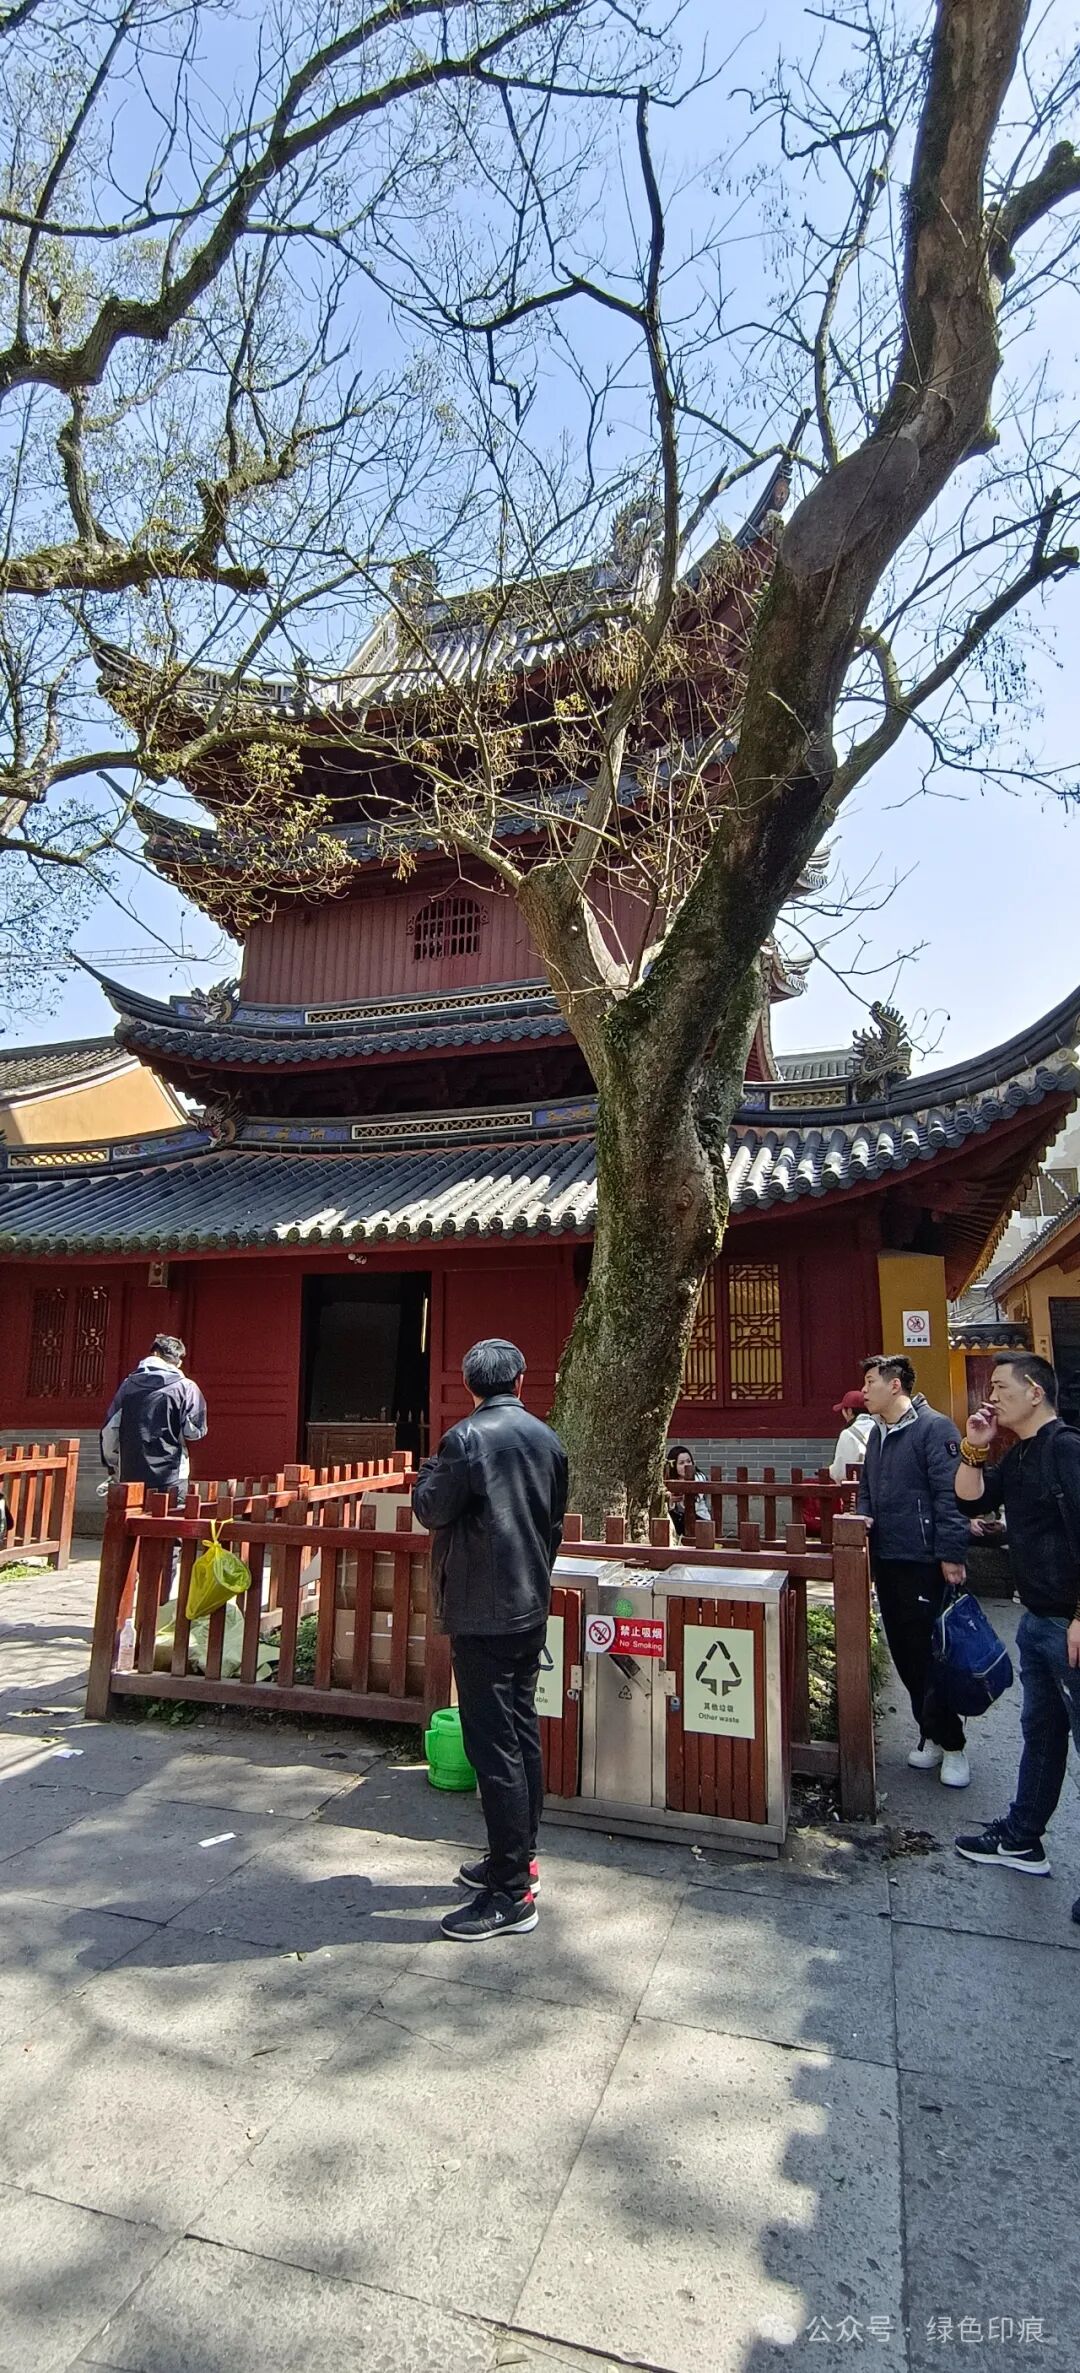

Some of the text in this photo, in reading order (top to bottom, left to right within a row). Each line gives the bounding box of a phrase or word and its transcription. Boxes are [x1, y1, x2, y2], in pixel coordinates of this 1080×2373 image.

[620, 1624, 663, 1639] 禁止吸烟
[619, 1639, 663, 1652] No Smoking
[703, 1702, 734, 1713] 其他垃圾
[698, 1712, 740, 1724] Other waste
